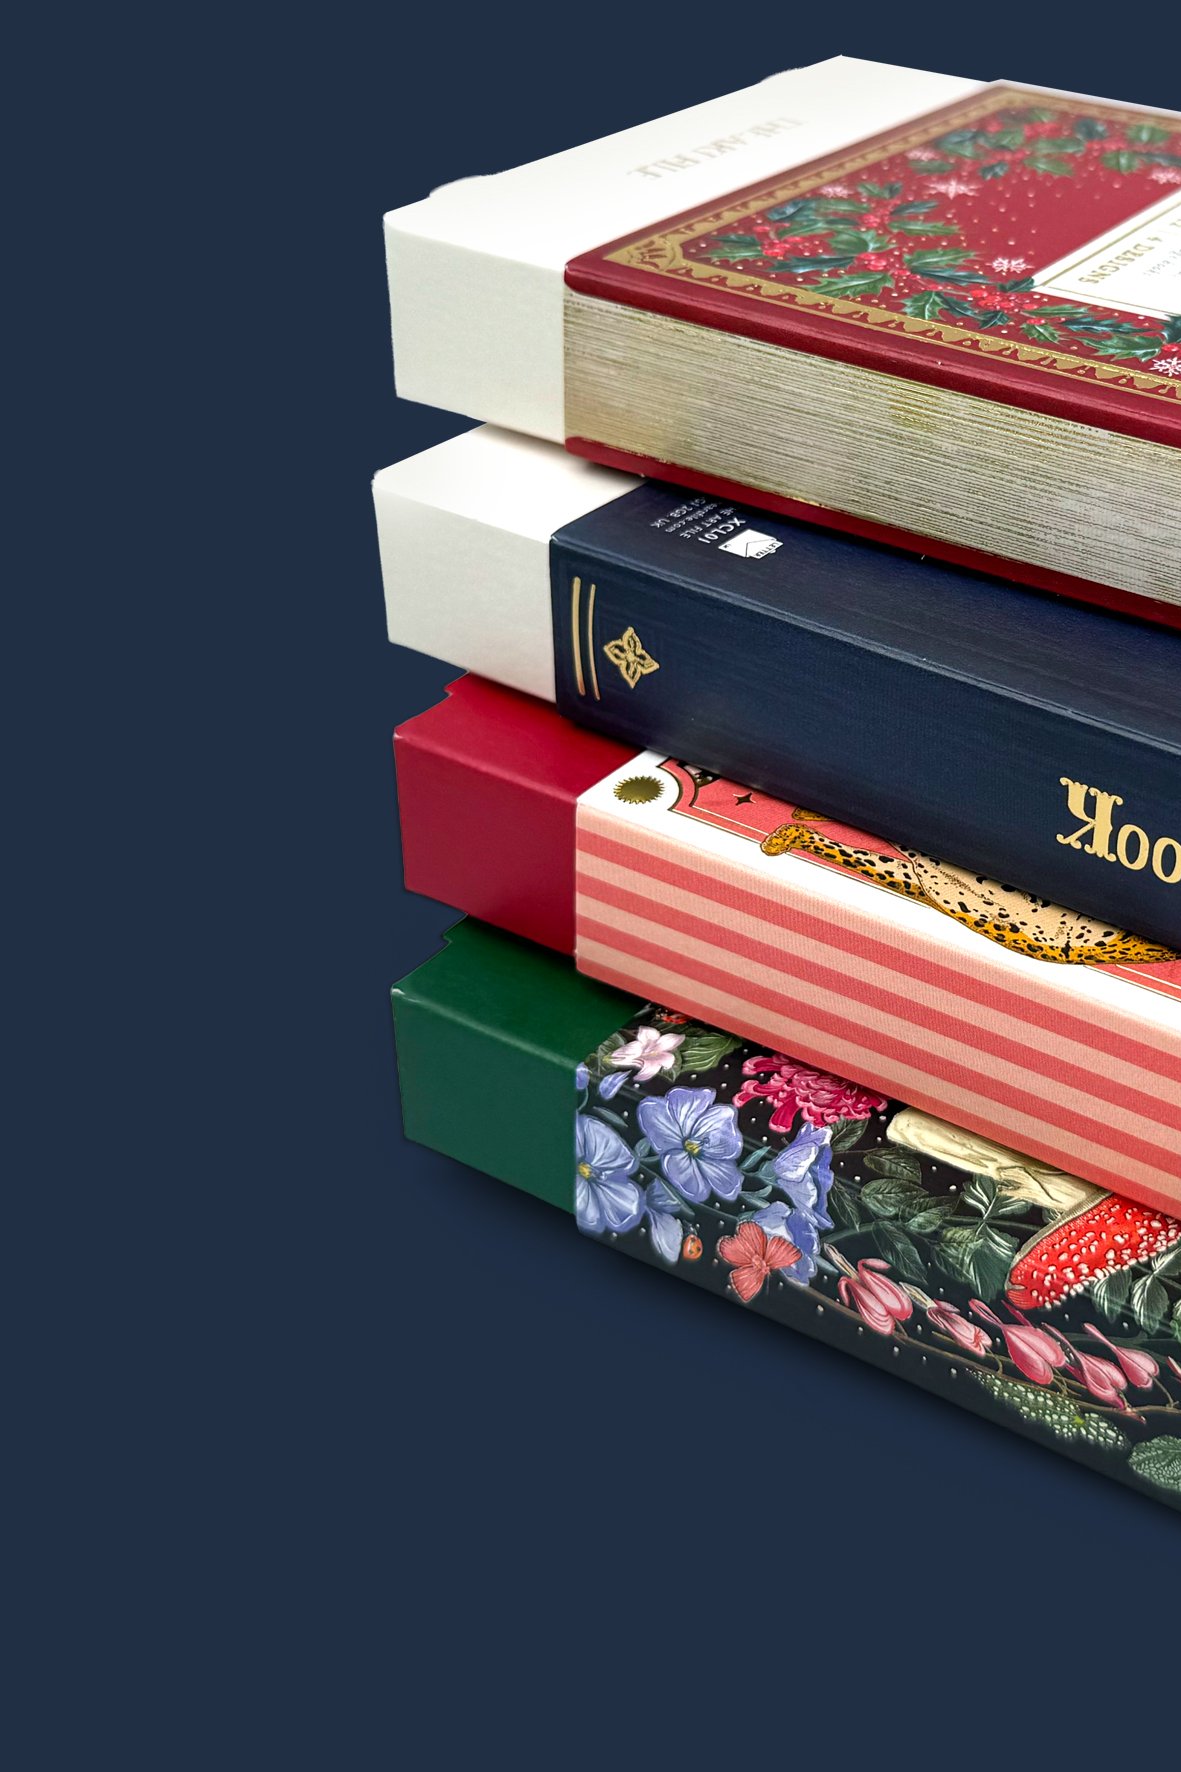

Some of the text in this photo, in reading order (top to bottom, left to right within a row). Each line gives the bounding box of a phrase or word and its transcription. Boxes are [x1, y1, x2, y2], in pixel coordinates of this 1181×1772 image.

[1078, 243, 1155, 284] DESIGNS
[701, 513, 721, 527] ART
[679, 525, 703, 538] FILE
